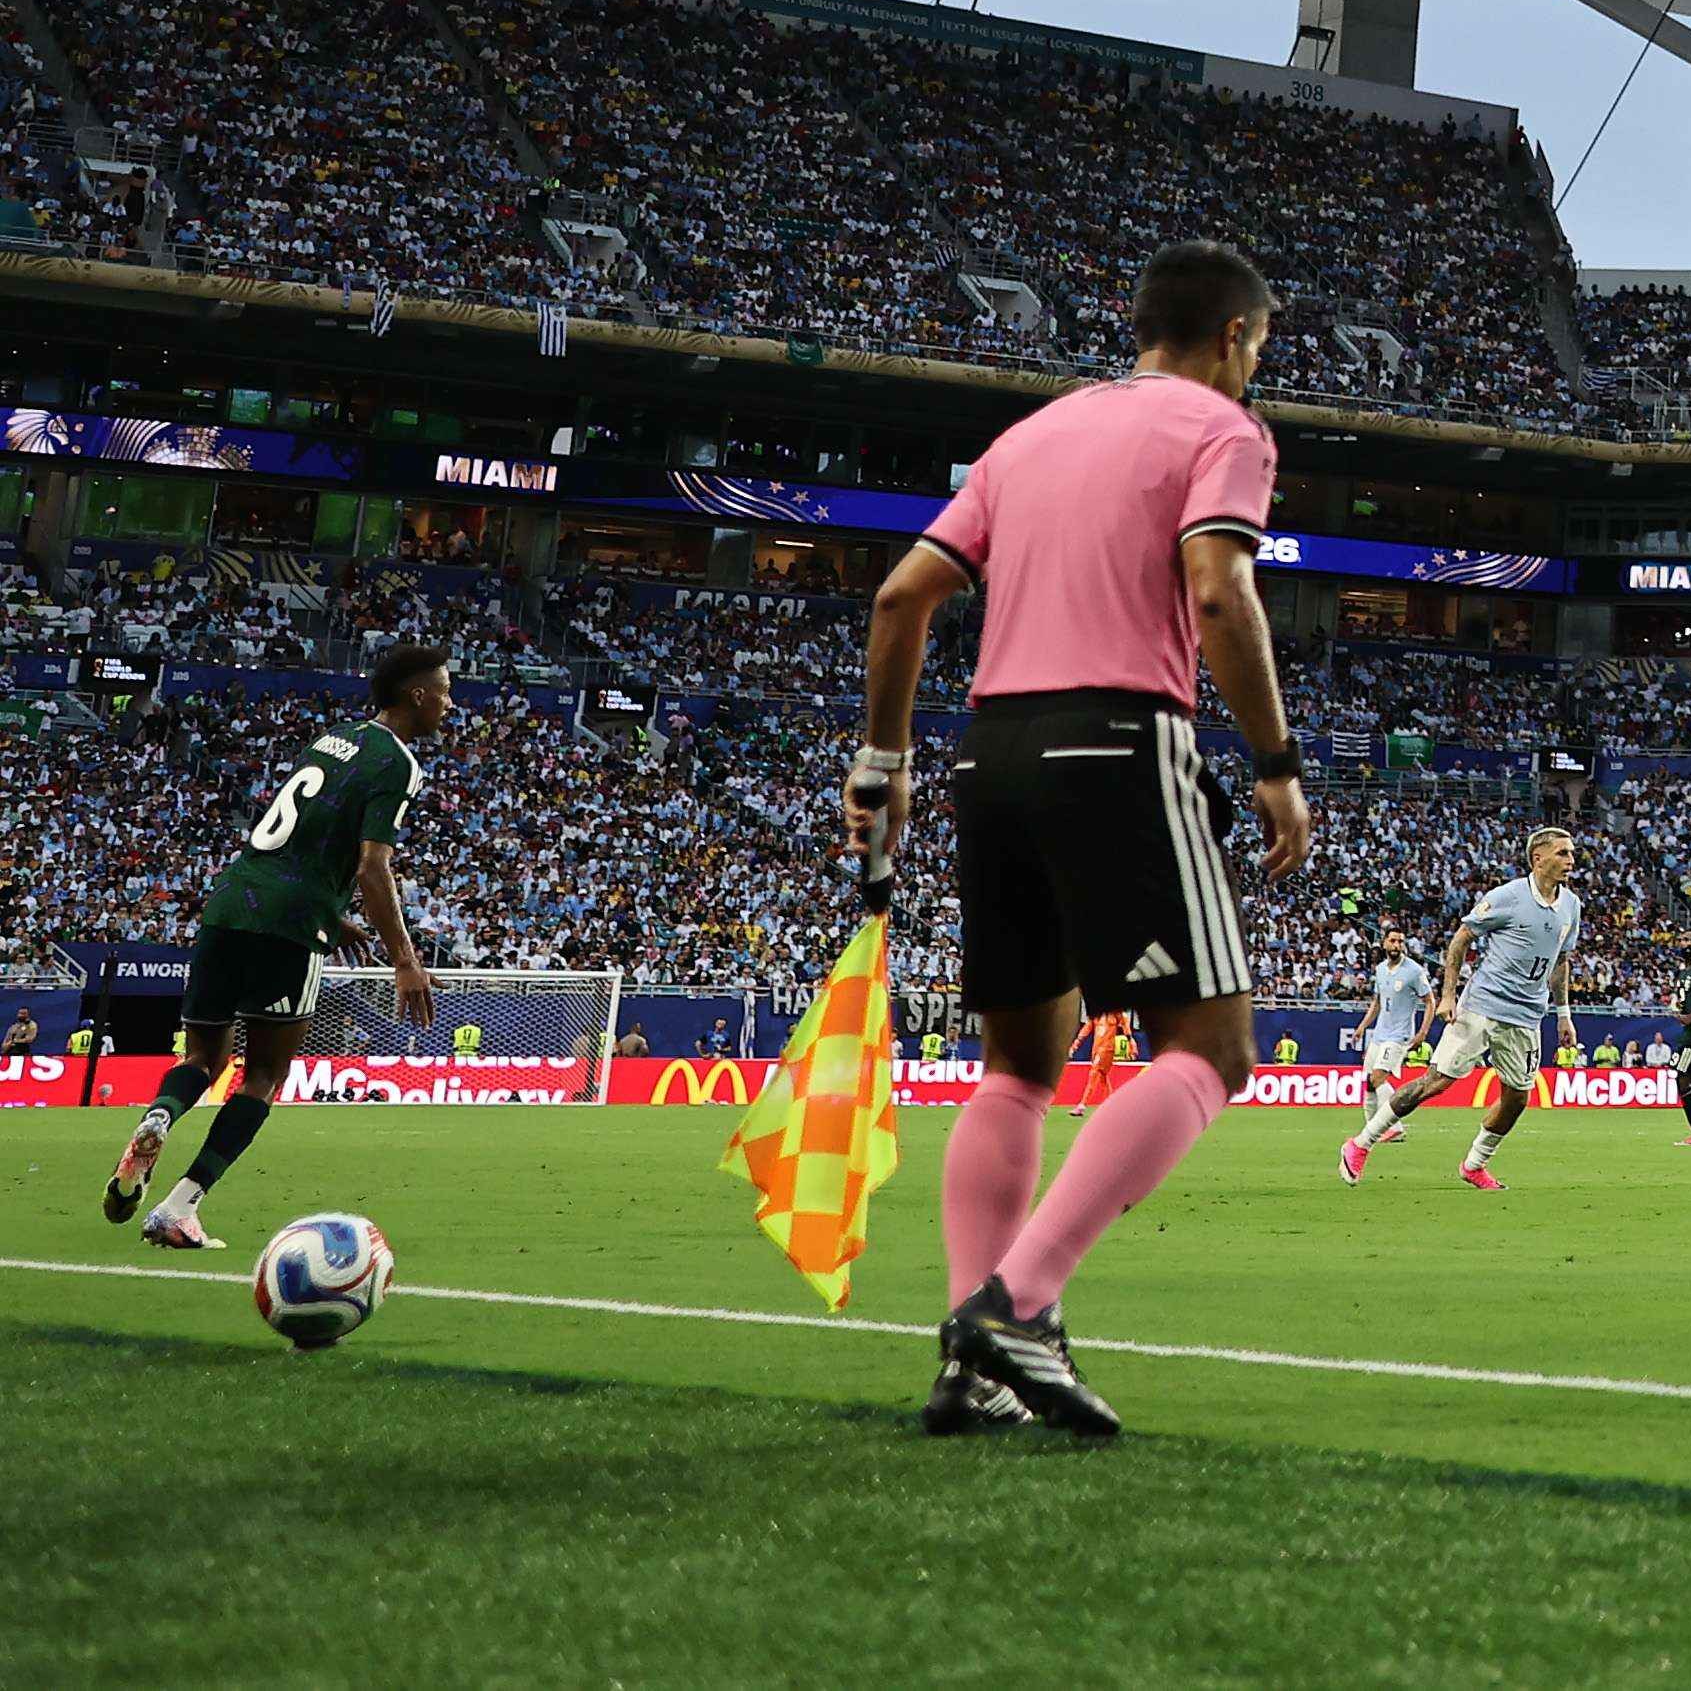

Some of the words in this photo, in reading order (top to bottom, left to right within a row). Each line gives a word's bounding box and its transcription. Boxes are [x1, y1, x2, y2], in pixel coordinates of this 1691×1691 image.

[1290, 81, 1324, 102] 308
[436, 455, 557, 491] MIAMI
[1256, 536, 1300, 563] 26
[1530, 956, 1549, 981] 13
